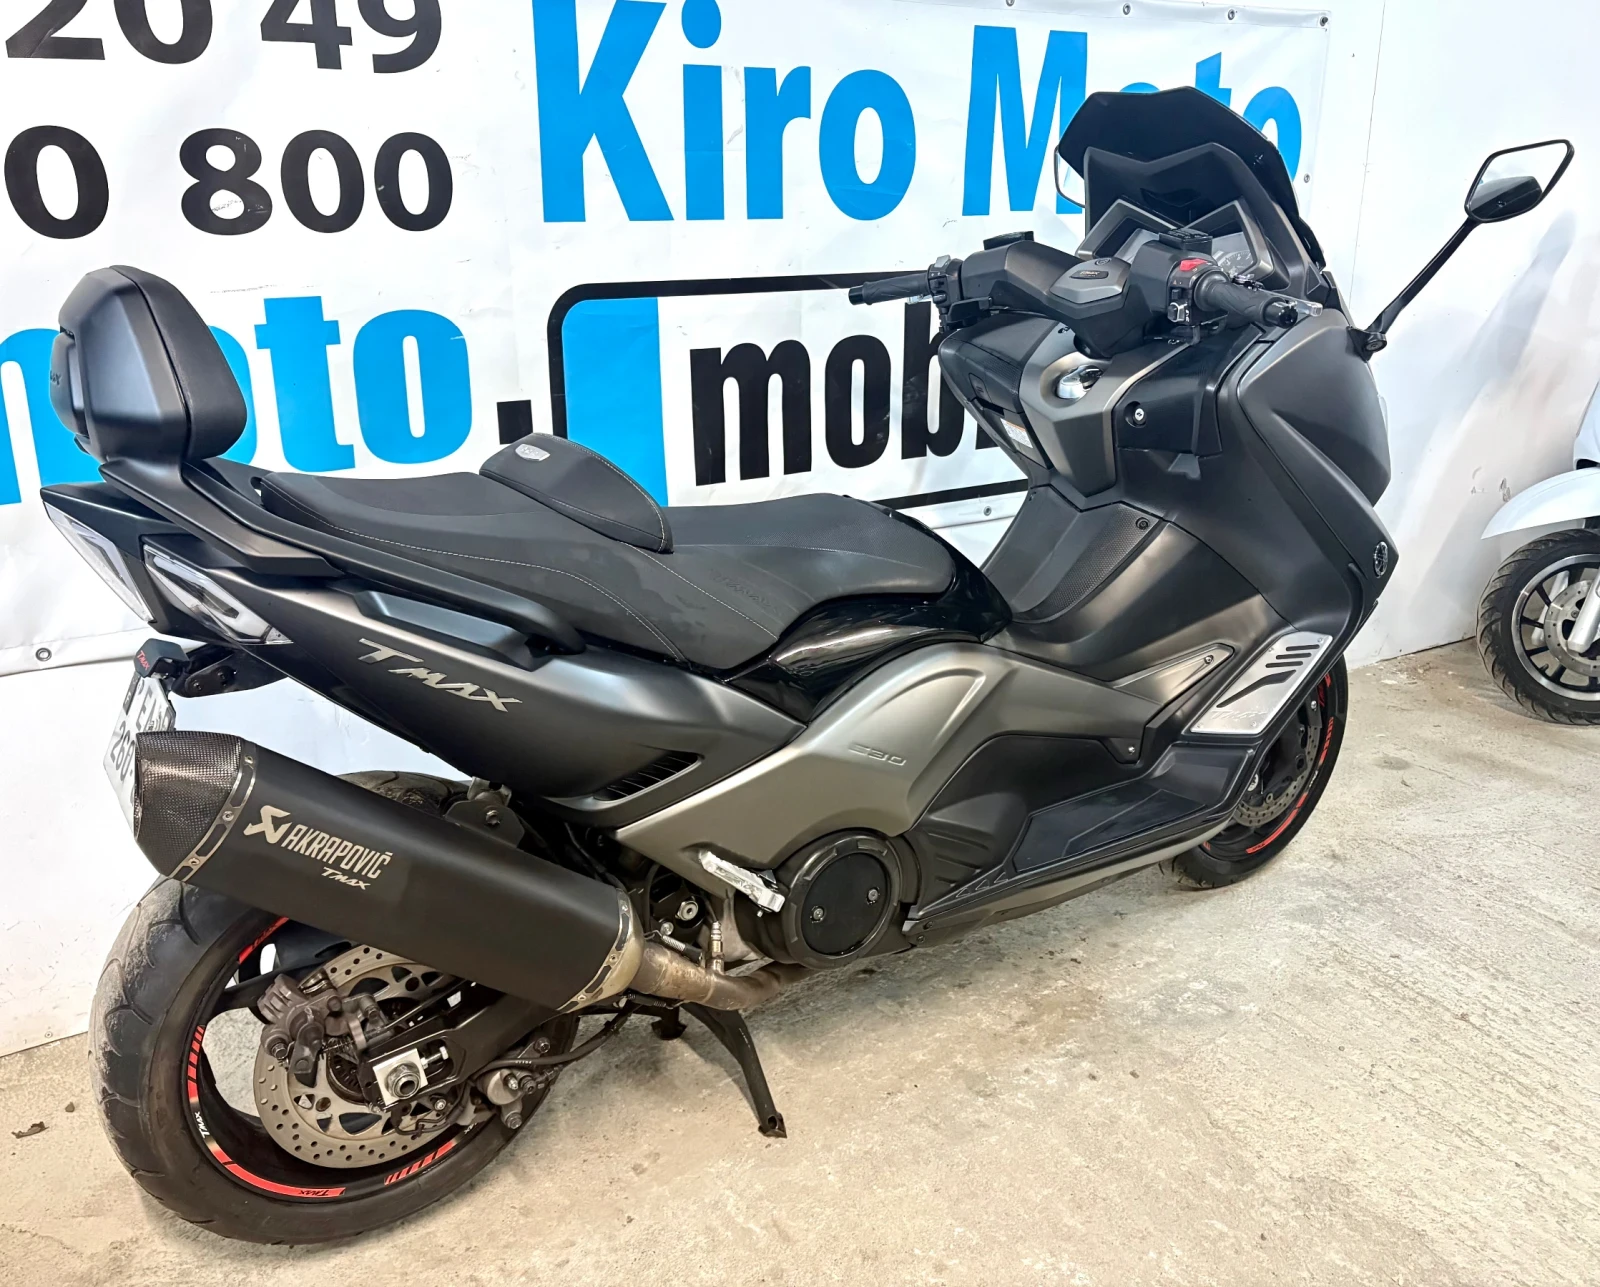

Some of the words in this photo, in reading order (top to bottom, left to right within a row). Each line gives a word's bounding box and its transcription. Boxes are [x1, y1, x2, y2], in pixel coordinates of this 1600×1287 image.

[5, 0, 213, 64] 20
[260, 0, 442, 73] 49
[532, 0, 915, 222] Kiro
[961, 25, 1302, 217] Mo
[4, 125, 109, 239] 0
[179, 128, 453, 235] 800
[358, 637, 523, 712] TMAX
